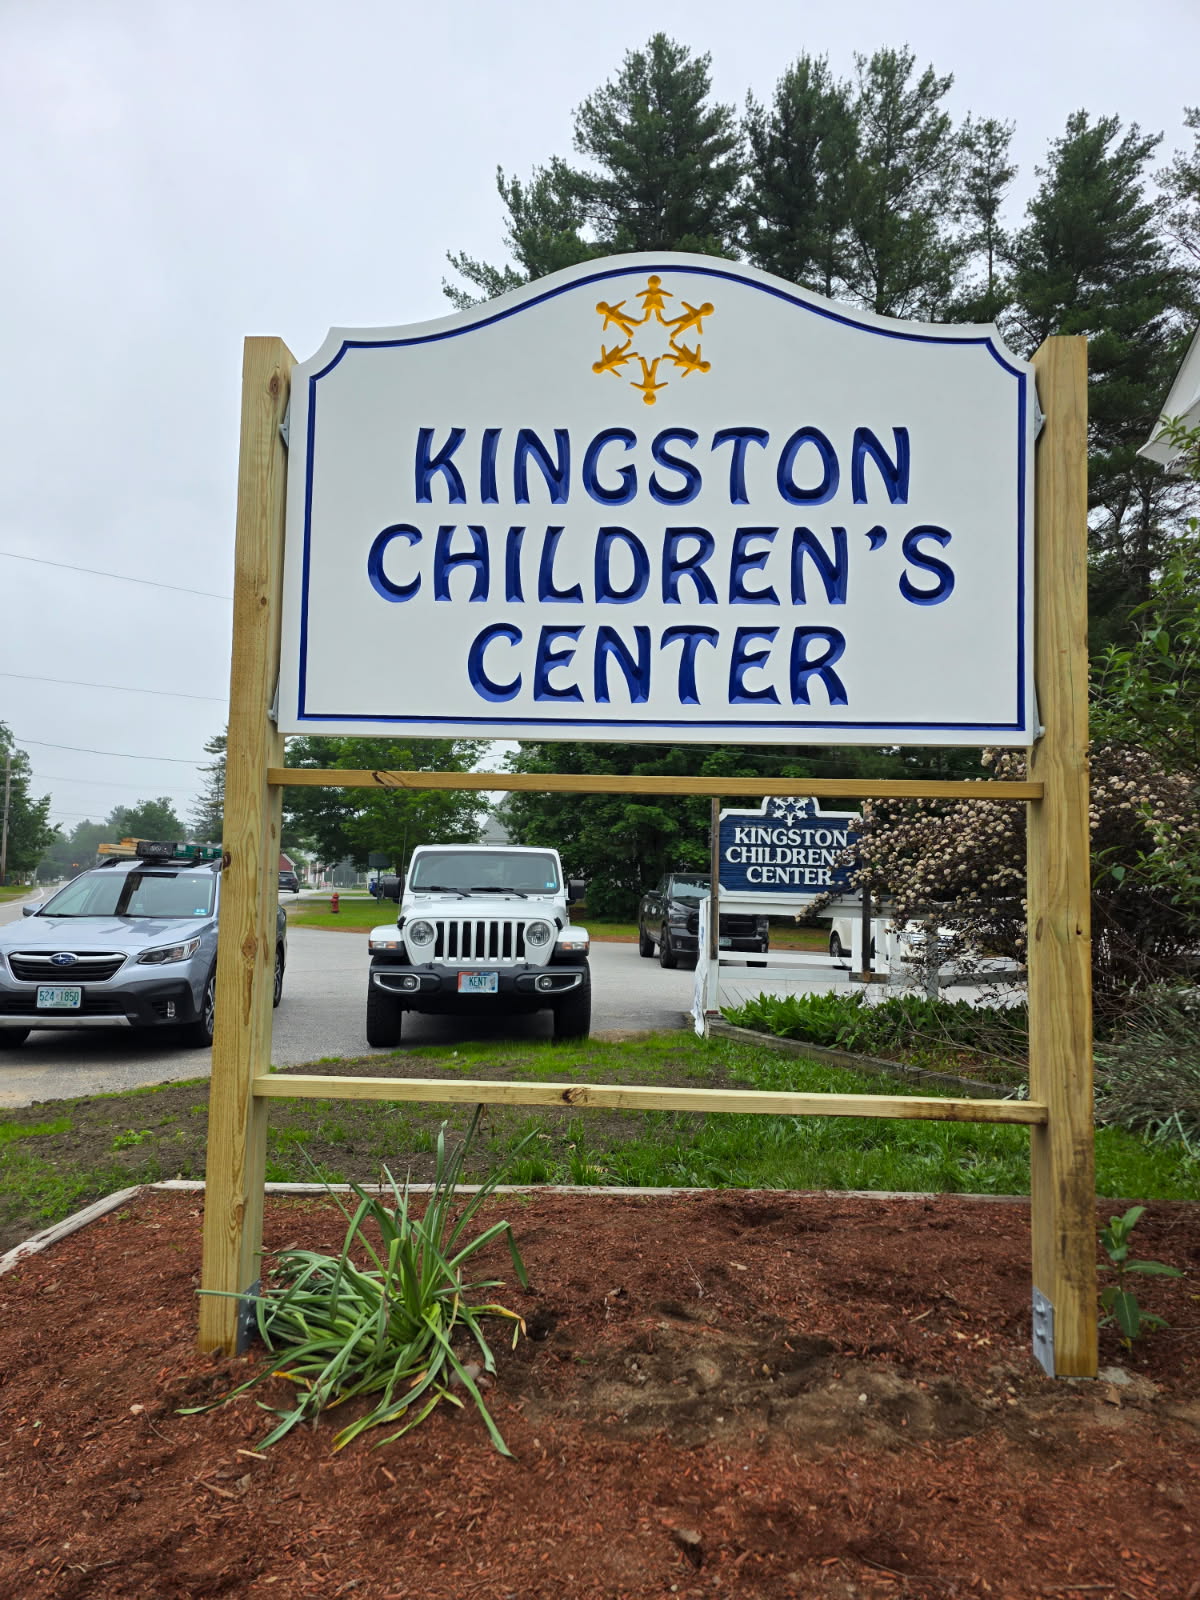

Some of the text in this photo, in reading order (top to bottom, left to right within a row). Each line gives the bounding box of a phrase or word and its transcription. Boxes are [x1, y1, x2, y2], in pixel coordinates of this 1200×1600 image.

[414, 426, 911, 507] KINGSTON
[367, 523, 956, 607] CHILDREN'S
[467, 622, 849, 706] CENTER
[734, 827, 849, 847] KINGSTON
[724, 846, 856, 867] CHILDREN
[746, 865, 833, 886] CENTER
[468, 976, 488, 987] KENT
